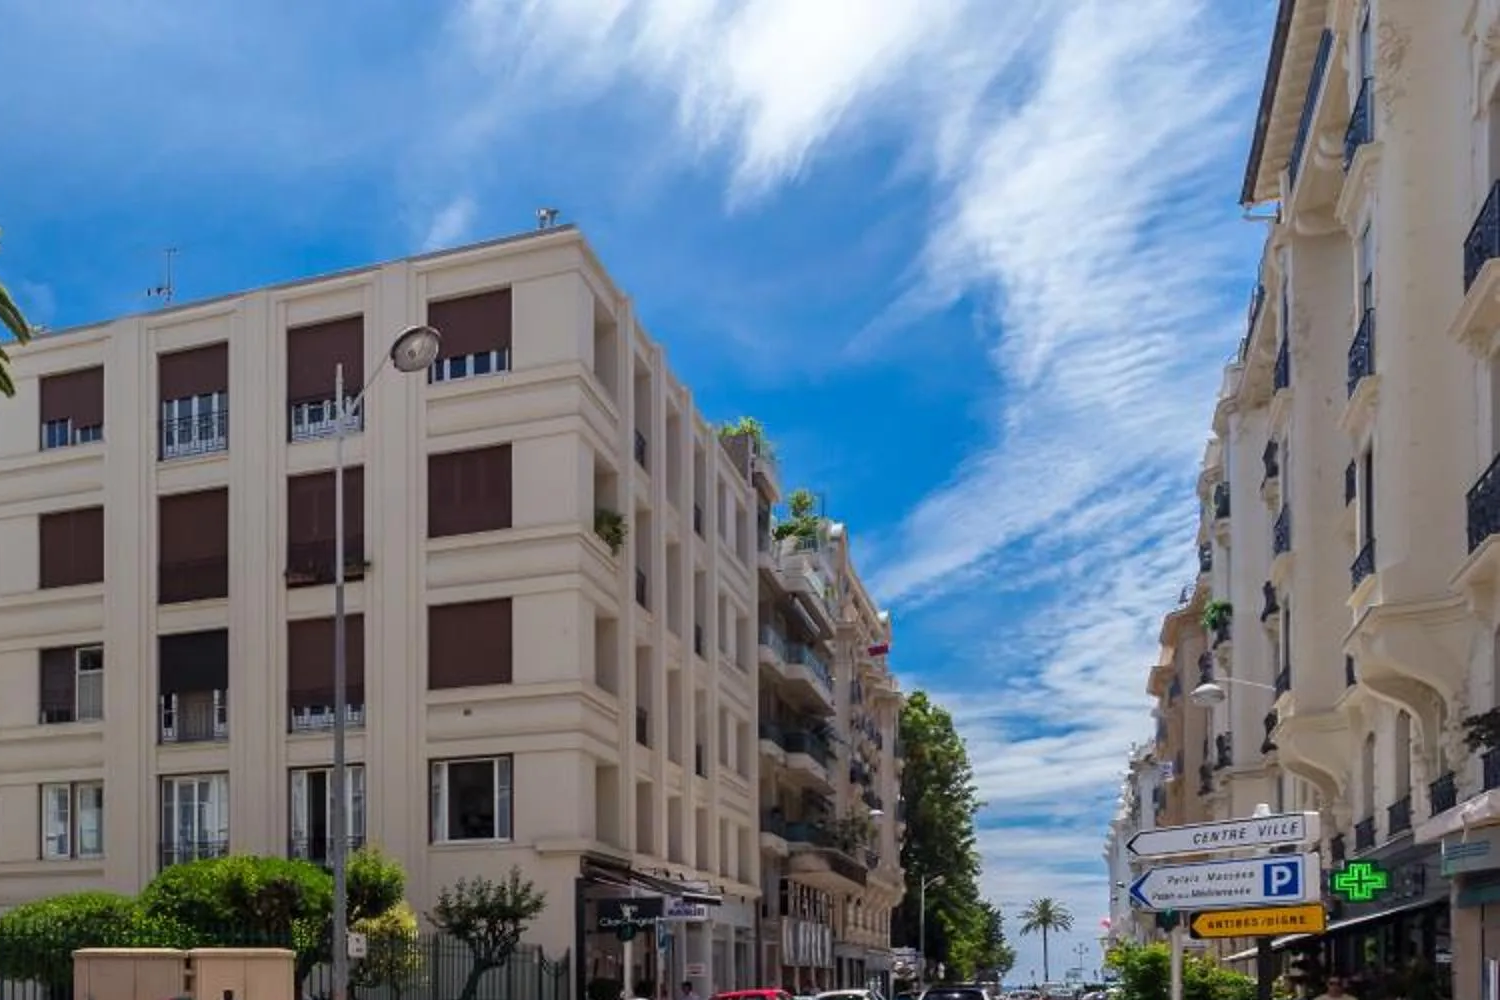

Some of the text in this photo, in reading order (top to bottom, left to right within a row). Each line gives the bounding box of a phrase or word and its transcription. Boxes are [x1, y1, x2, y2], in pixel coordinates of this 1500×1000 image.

[1192, 821, 1299, 845] CENTRE VILLE
[1271, 865, 1292, 894] P
